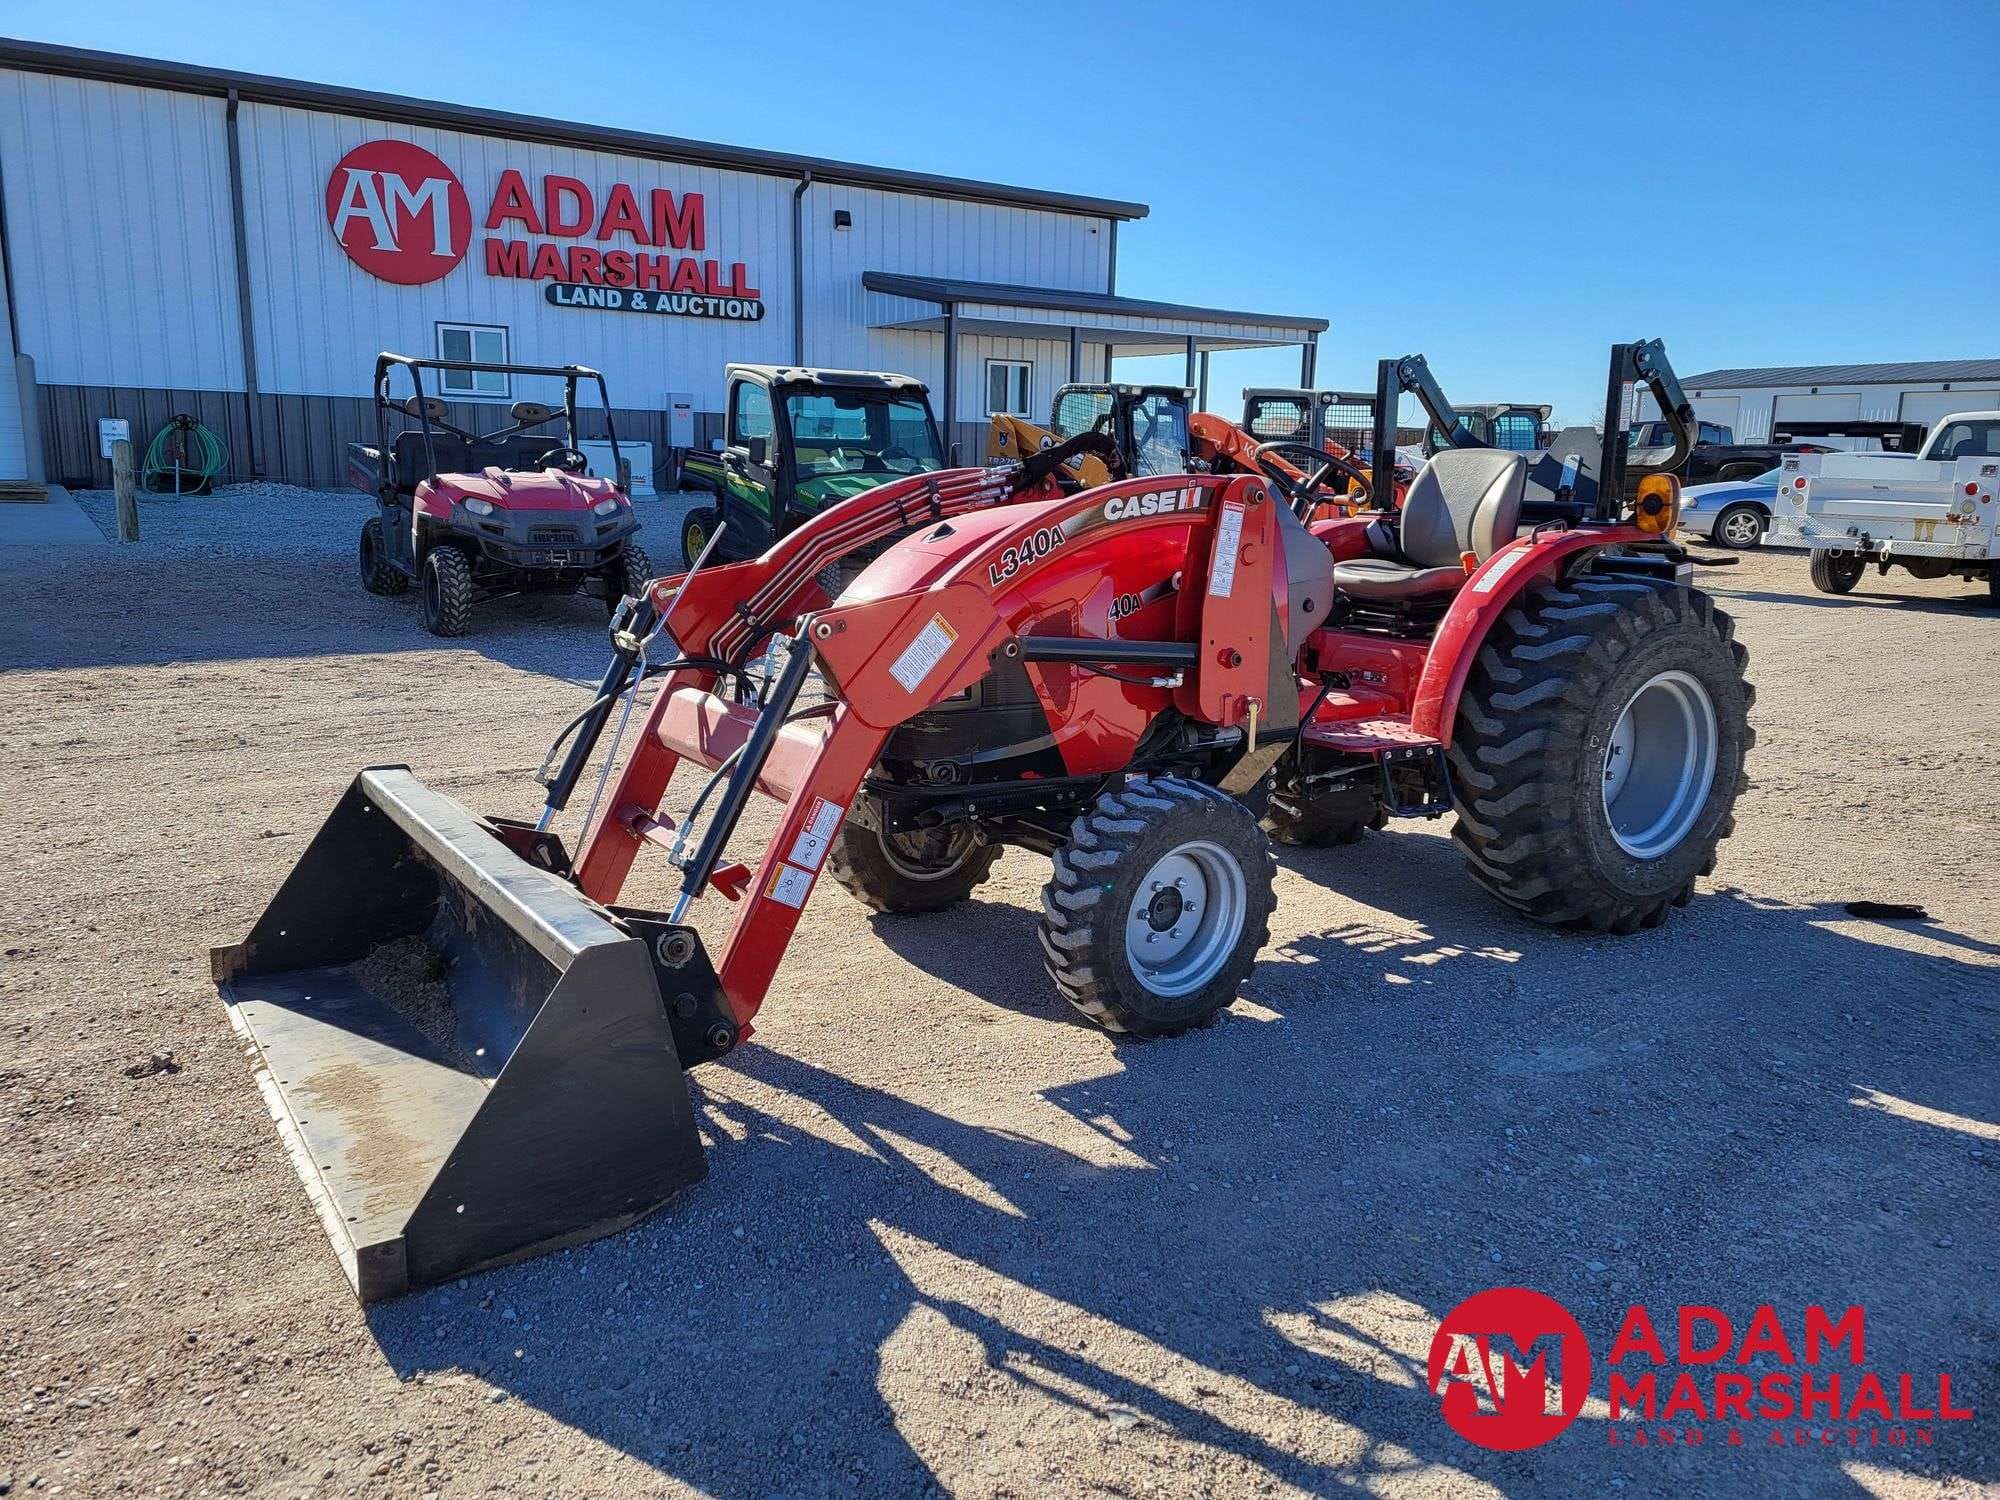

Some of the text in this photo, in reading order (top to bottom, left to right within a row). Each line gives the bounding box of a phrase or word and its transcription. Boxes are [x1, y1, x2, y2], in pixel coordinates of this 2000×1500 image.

[333, 168, 456, 257] AM
[485, 169, 705, 251] ADAM
[485, 238, 761, 299] MARSHALL
[555, 284, 759, 320] LAND & AUCTION
[1104, 491, 1176, 521] CASE
[988, 524, 1065, 587] L340A
[1108, 593, 1142, 622] 40A
